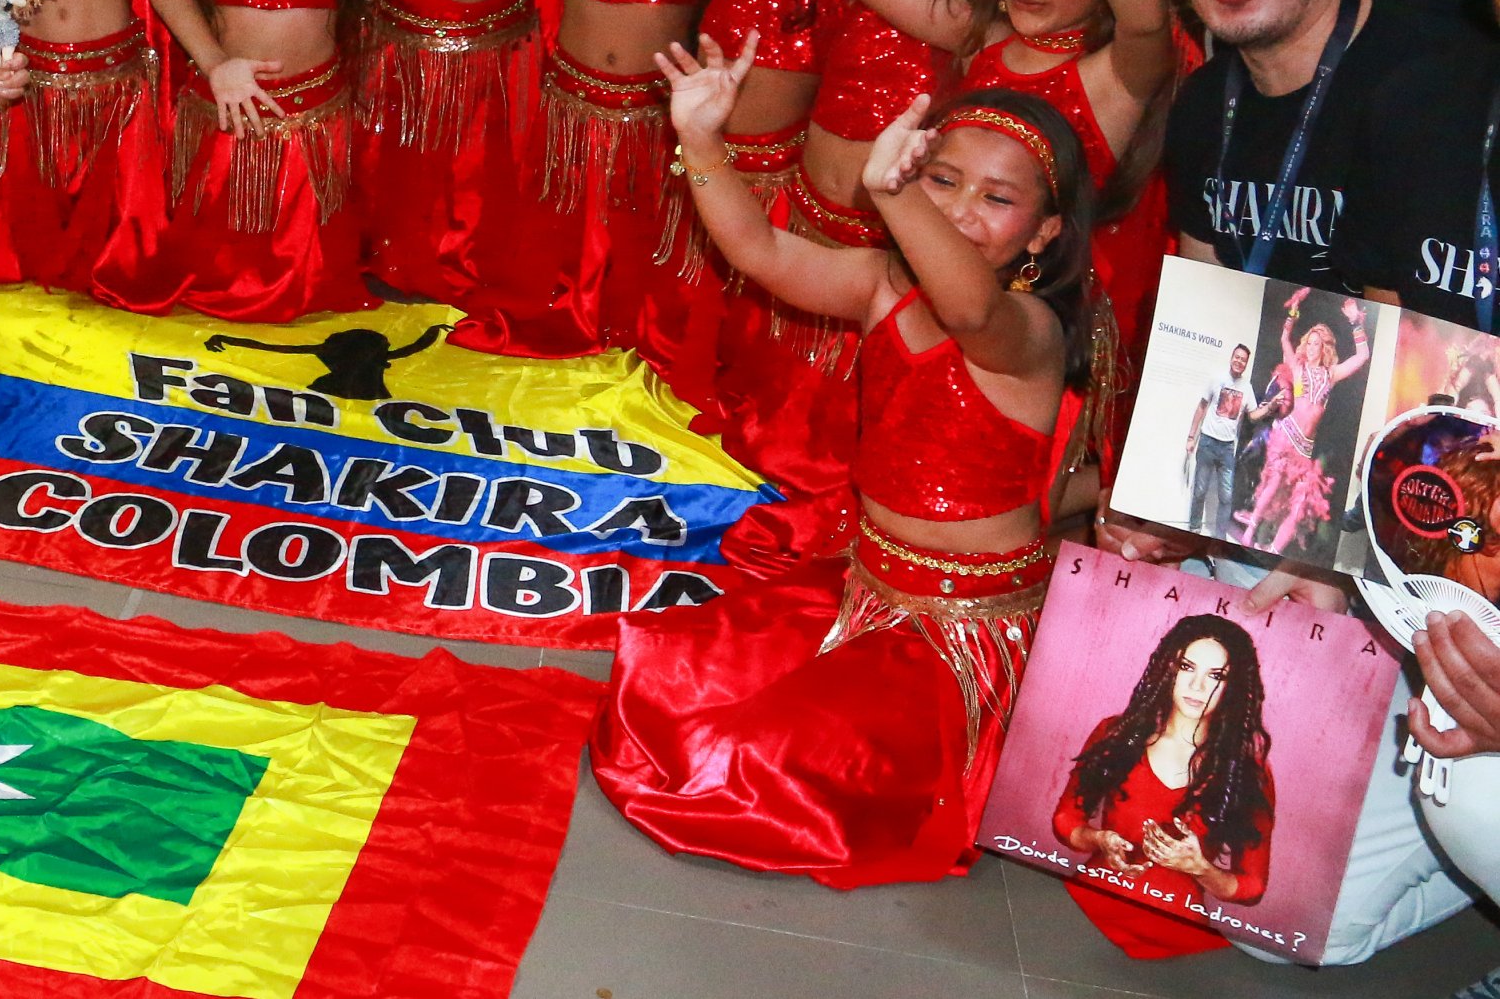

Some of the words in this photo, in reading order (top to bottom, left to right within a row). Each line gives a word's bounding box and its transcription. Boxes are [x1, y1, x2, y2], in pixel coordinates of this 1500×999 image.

[1158, 321, 1198, 341] SHAKIRA'S
[1199, 333, 1223, 348] WORLD
[130, 353, 341, 429] Fan
[53, 409, 690, 547] SHAKIRA
[1071, 557, 1378, 657] SHAKIRA
[1142, 880, 1174, 903] los
